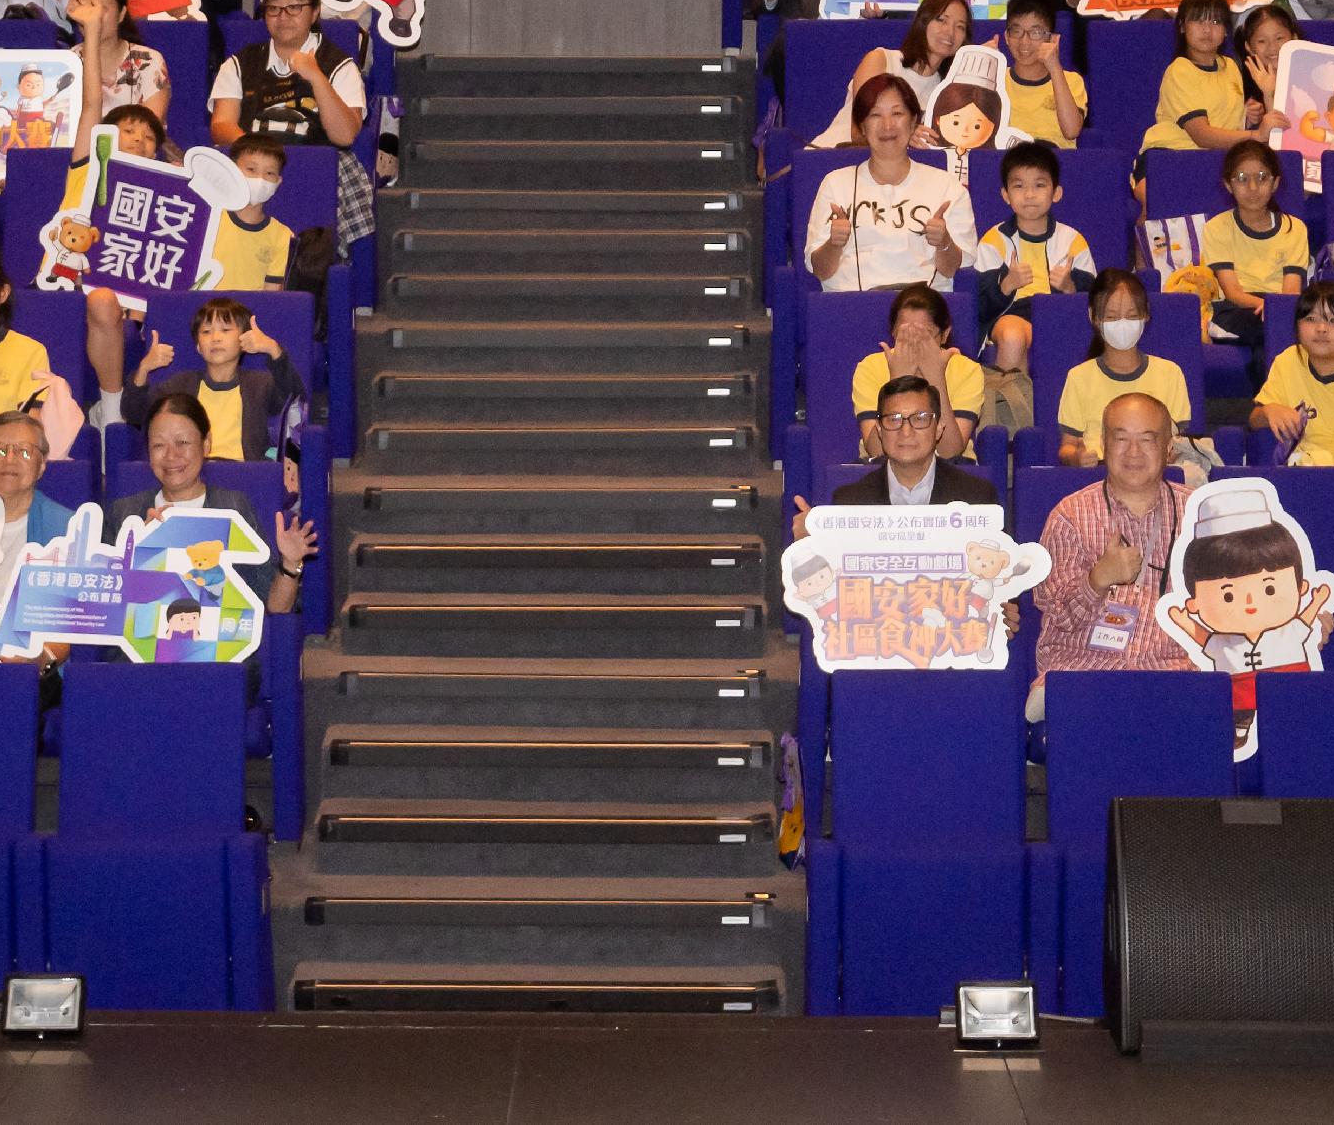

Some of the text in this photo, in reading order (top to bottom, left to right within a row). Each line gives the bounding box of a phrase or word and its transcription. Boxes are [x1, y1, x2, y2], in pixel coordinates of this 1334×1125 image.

[108, 181, 195, 243] 國安
[97, 232, 185, 289] 家好
[844, 555, 964, 571] 國家安全互動劇場
[837, 576, 972, 621] 國安家好
[220, 617, 253, 634] 周年
[825, 617, 988, 668] 社區食神大賽
